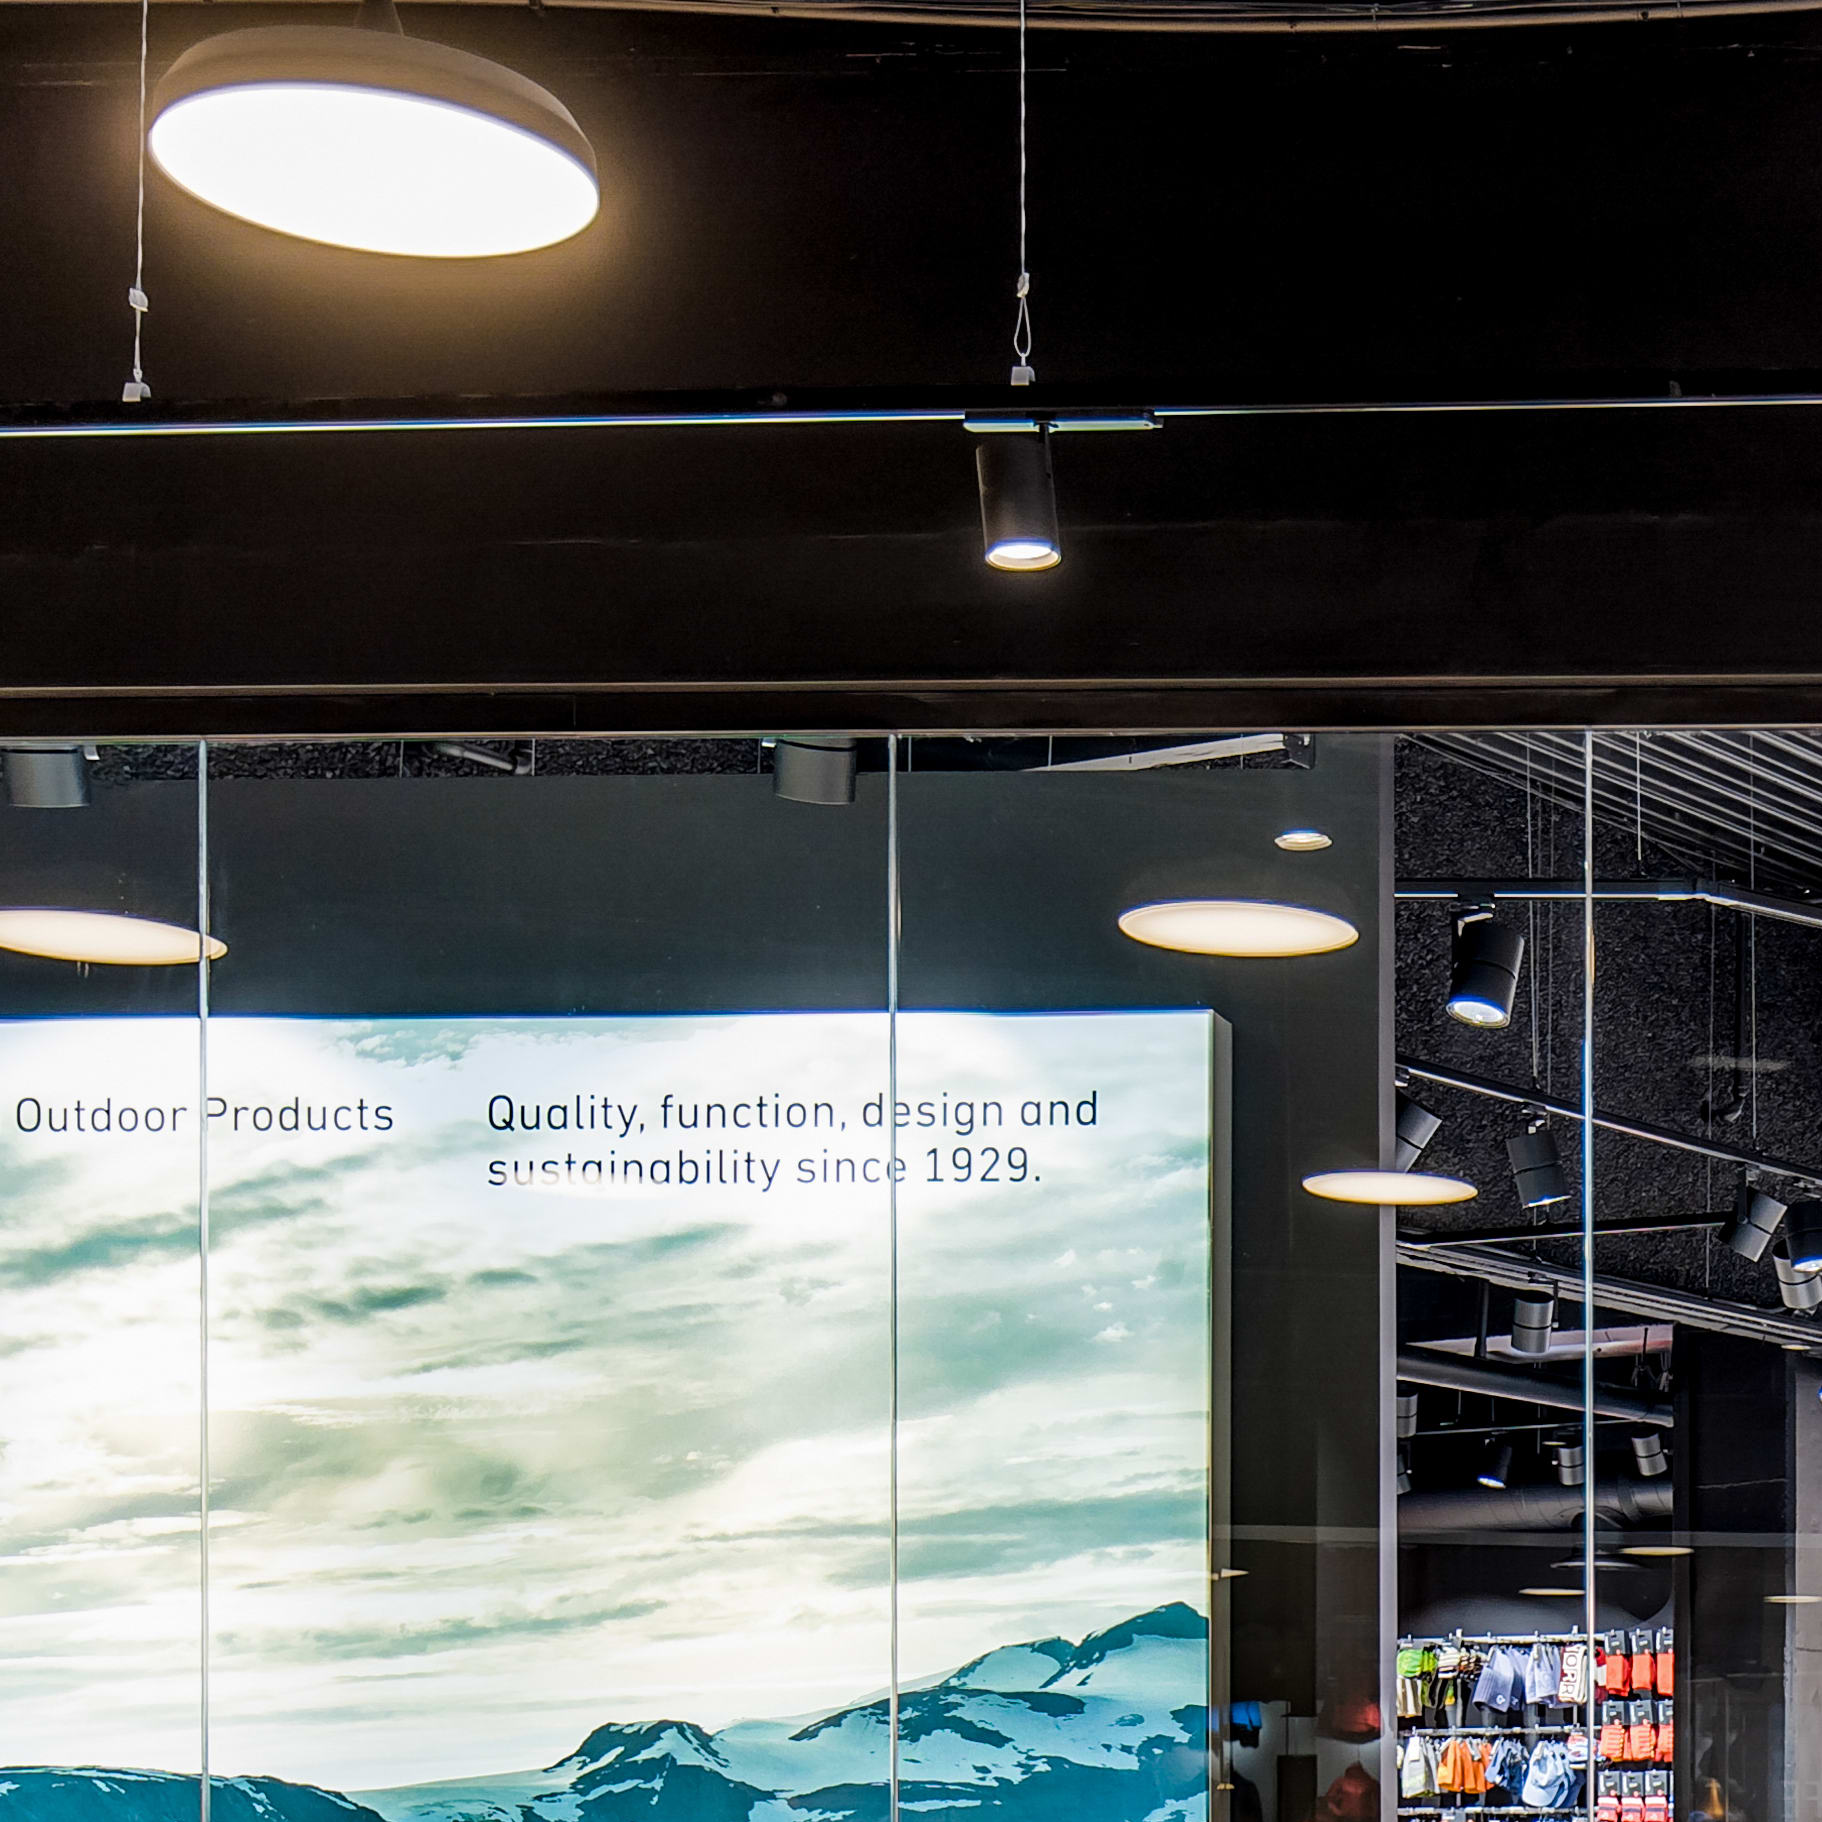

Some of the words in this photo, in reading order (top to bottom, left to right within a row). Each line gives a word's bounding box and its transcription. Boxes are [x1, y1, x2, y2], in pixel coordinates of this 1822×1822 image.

[15, 1096, 188, 1133] Outdoor
[206, 1096, 395, 1132] Products
[487, 1093, 646, 1137] Quality,
[661, 1092, 848, 1133] function,
[862, 1091, 1004, 1136] design
[1020, 1090, 1099, 1127] and
[487, 1147, 780, 1192] sustainability
[797, 1147, 907, 1184] since
[926, 1146, 1043, 1184] 1929.
